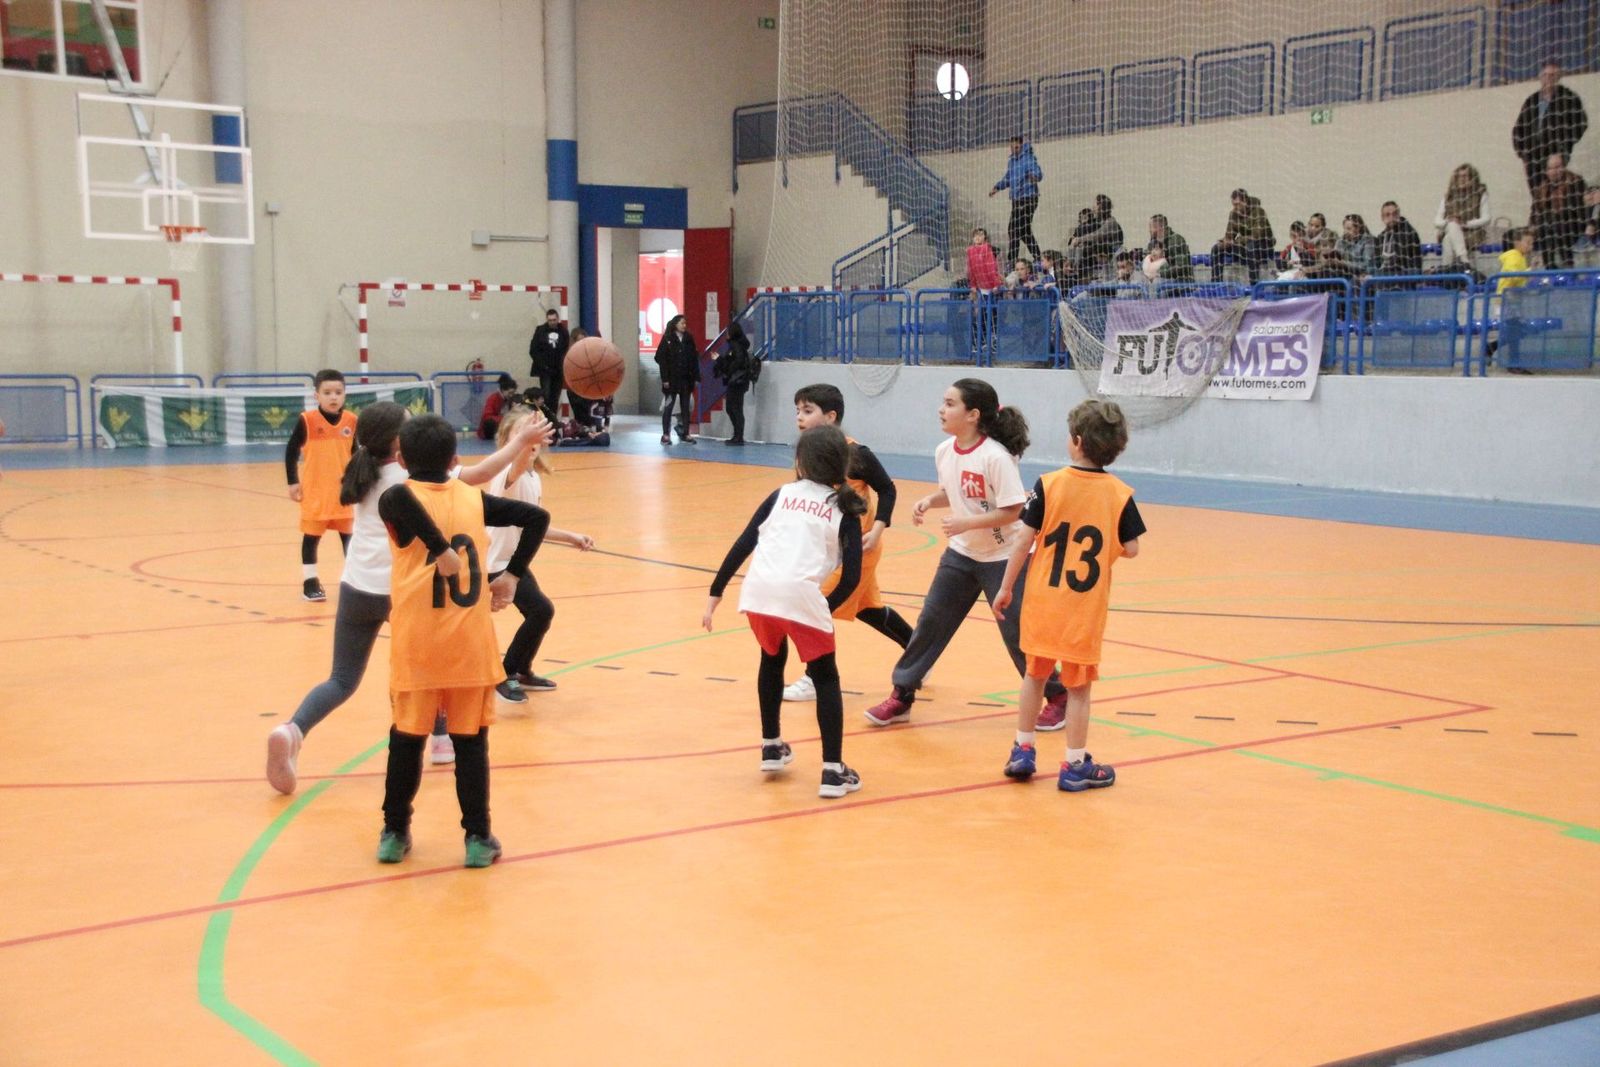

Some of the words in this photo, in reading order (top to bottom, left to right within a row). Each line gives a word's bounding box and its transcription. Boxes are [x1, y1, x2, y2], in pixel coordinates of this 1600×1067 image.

[1254, 321, 1309, 335] salamanca
[425, 533, 482, 608] 10
[1043, 521, 1103, 593] 13
